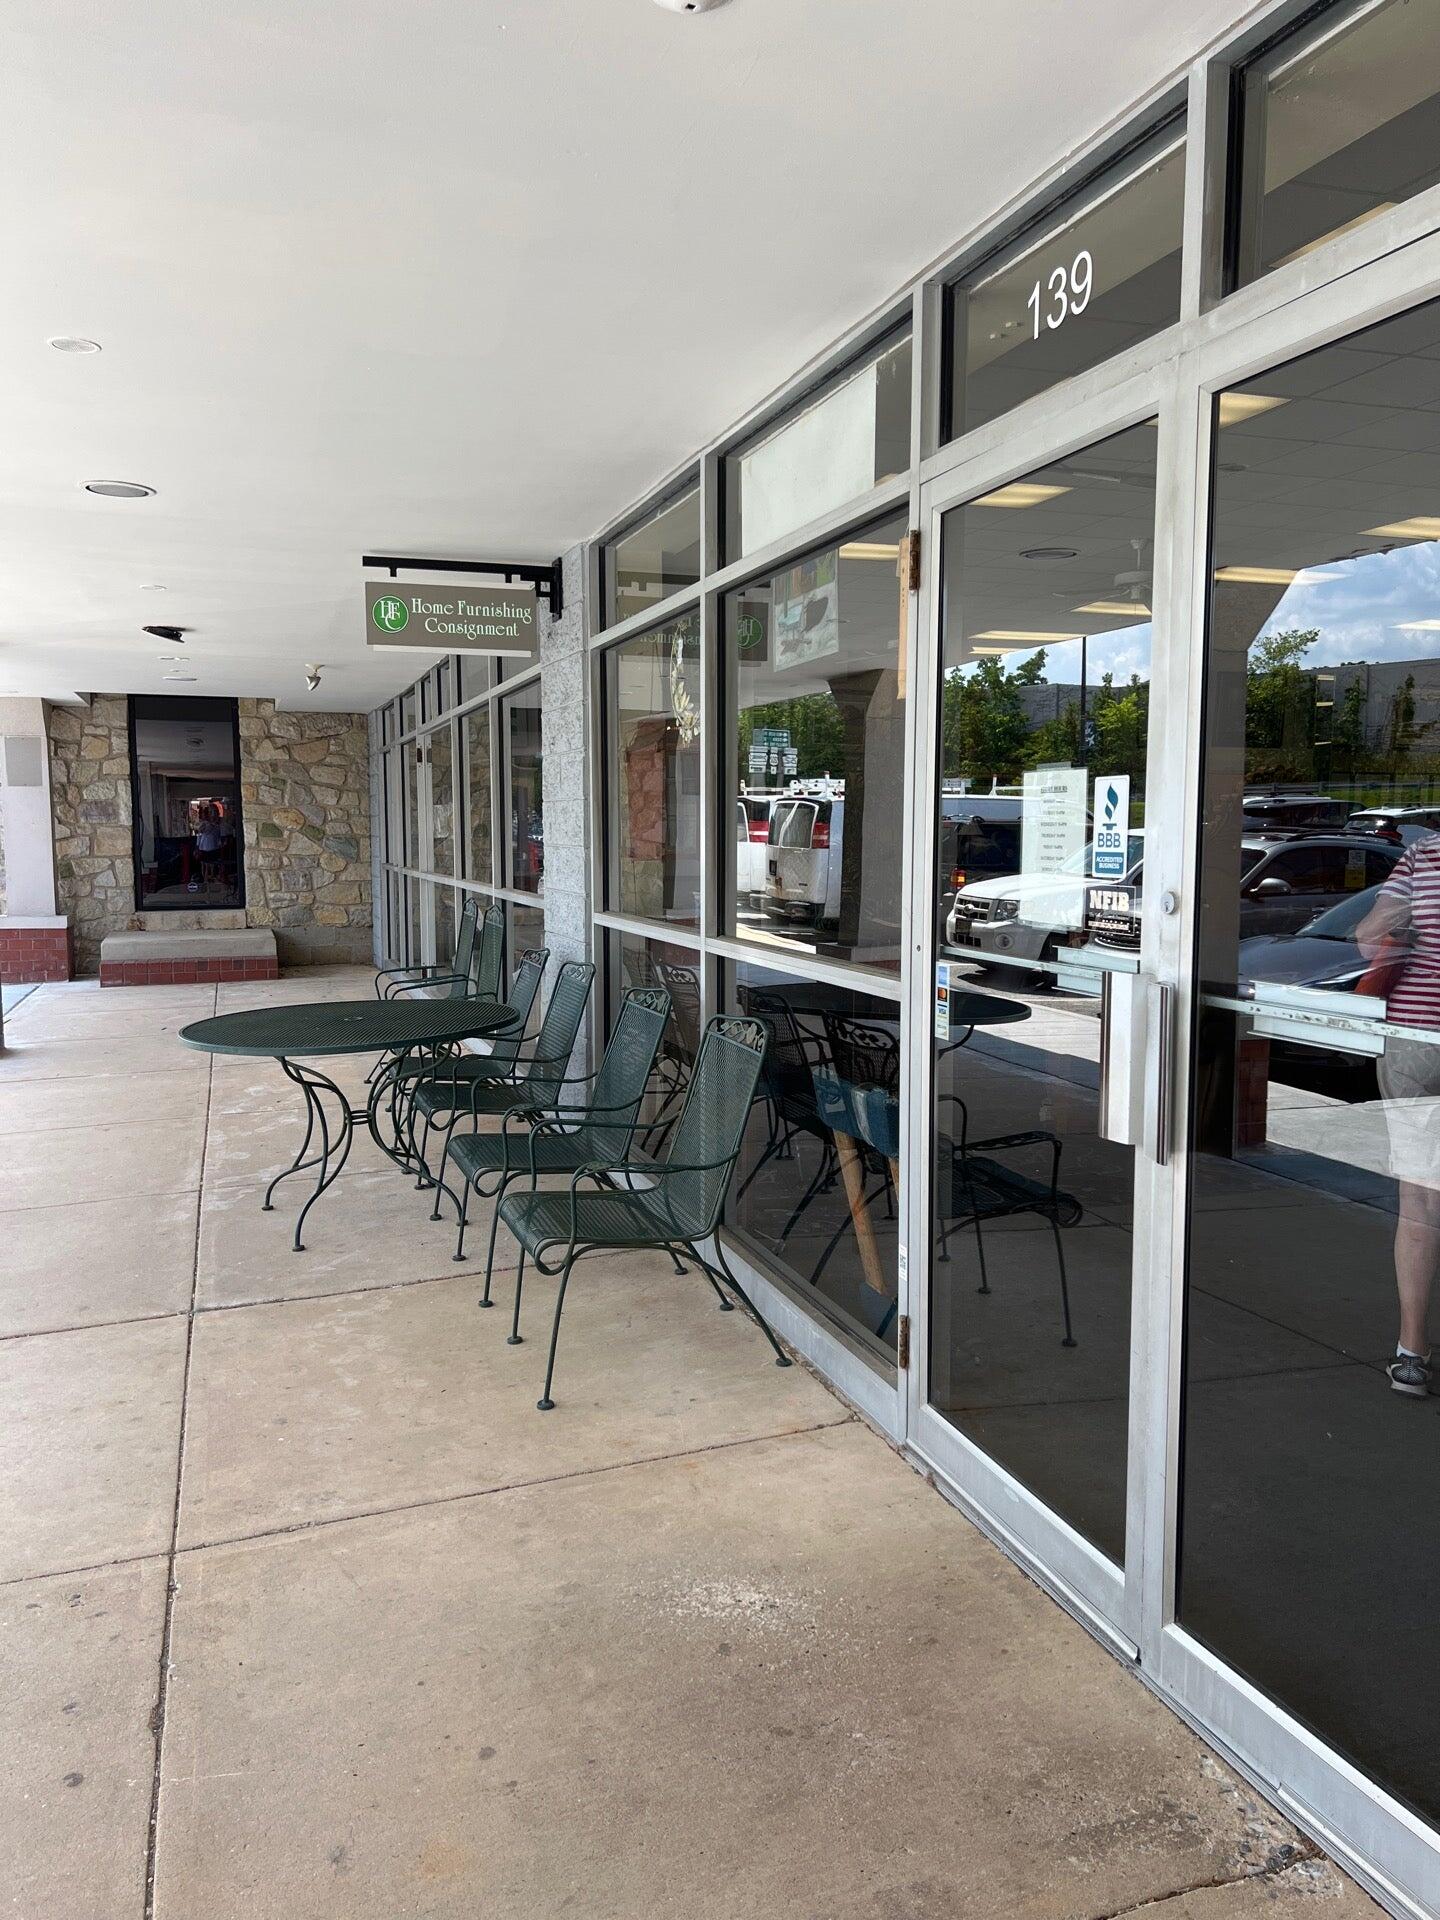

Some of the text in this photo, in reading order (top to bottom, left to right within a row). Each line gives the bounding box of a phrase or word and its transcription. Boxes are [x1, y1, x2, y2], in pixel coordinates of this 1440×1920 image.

[1027, 250, 1093, 340] 139
[411, 598, 532, 624] Home Furnishing
[424, 618, 520, 640] Consignment
[1097, 832, 1121, 848] BBB
[1089, 889, 1130, 912] NFIB
